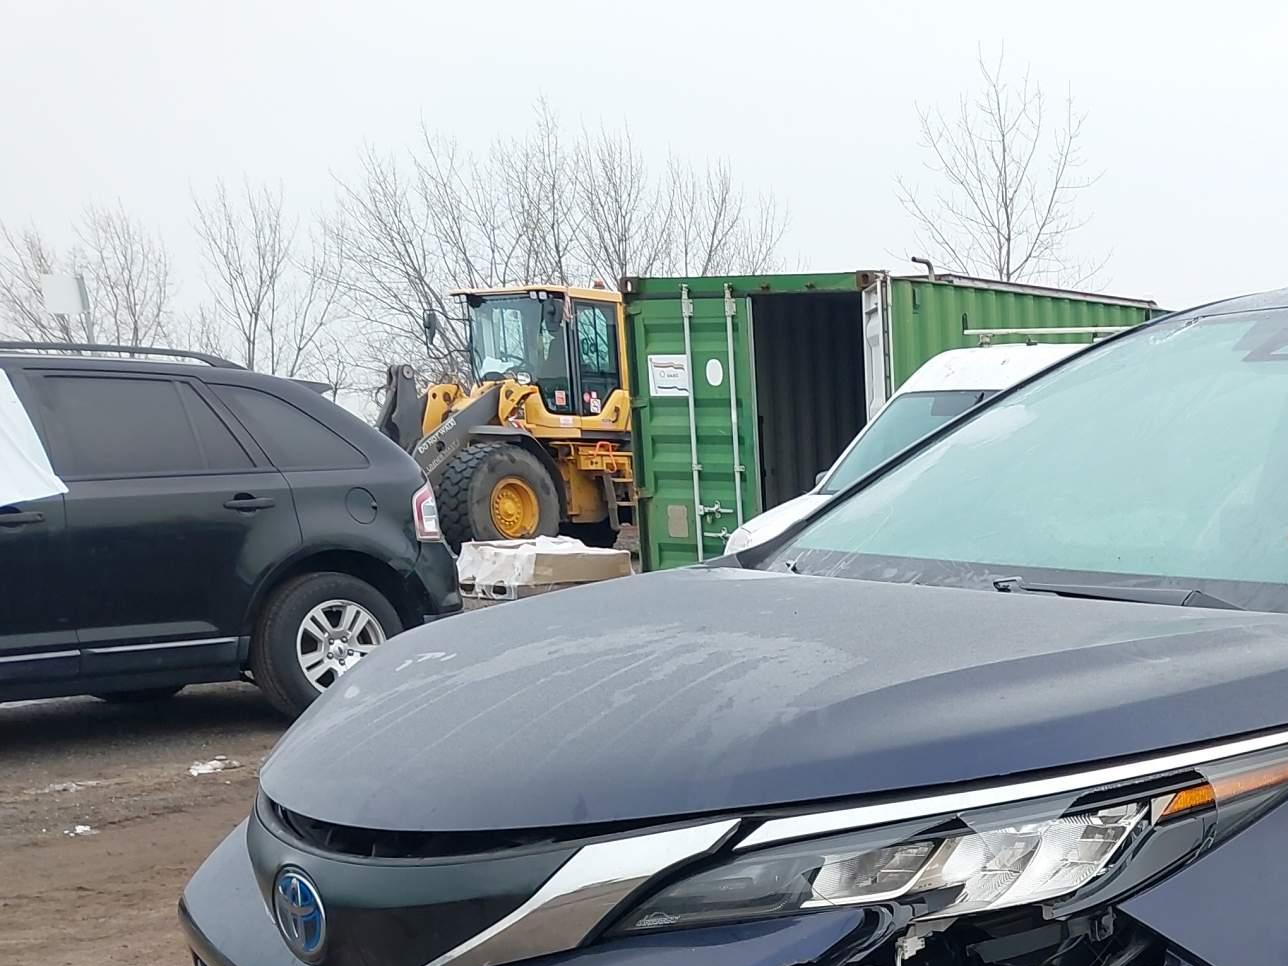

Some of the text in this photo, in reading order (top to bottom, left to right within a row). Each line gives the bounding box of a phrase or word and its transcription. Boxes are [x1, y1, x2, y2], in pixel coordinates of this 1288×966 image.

[418, 442, 429, 454] DO
[426, 431, 441, 447] NOT
[438, 417, 457, 436] WALK
